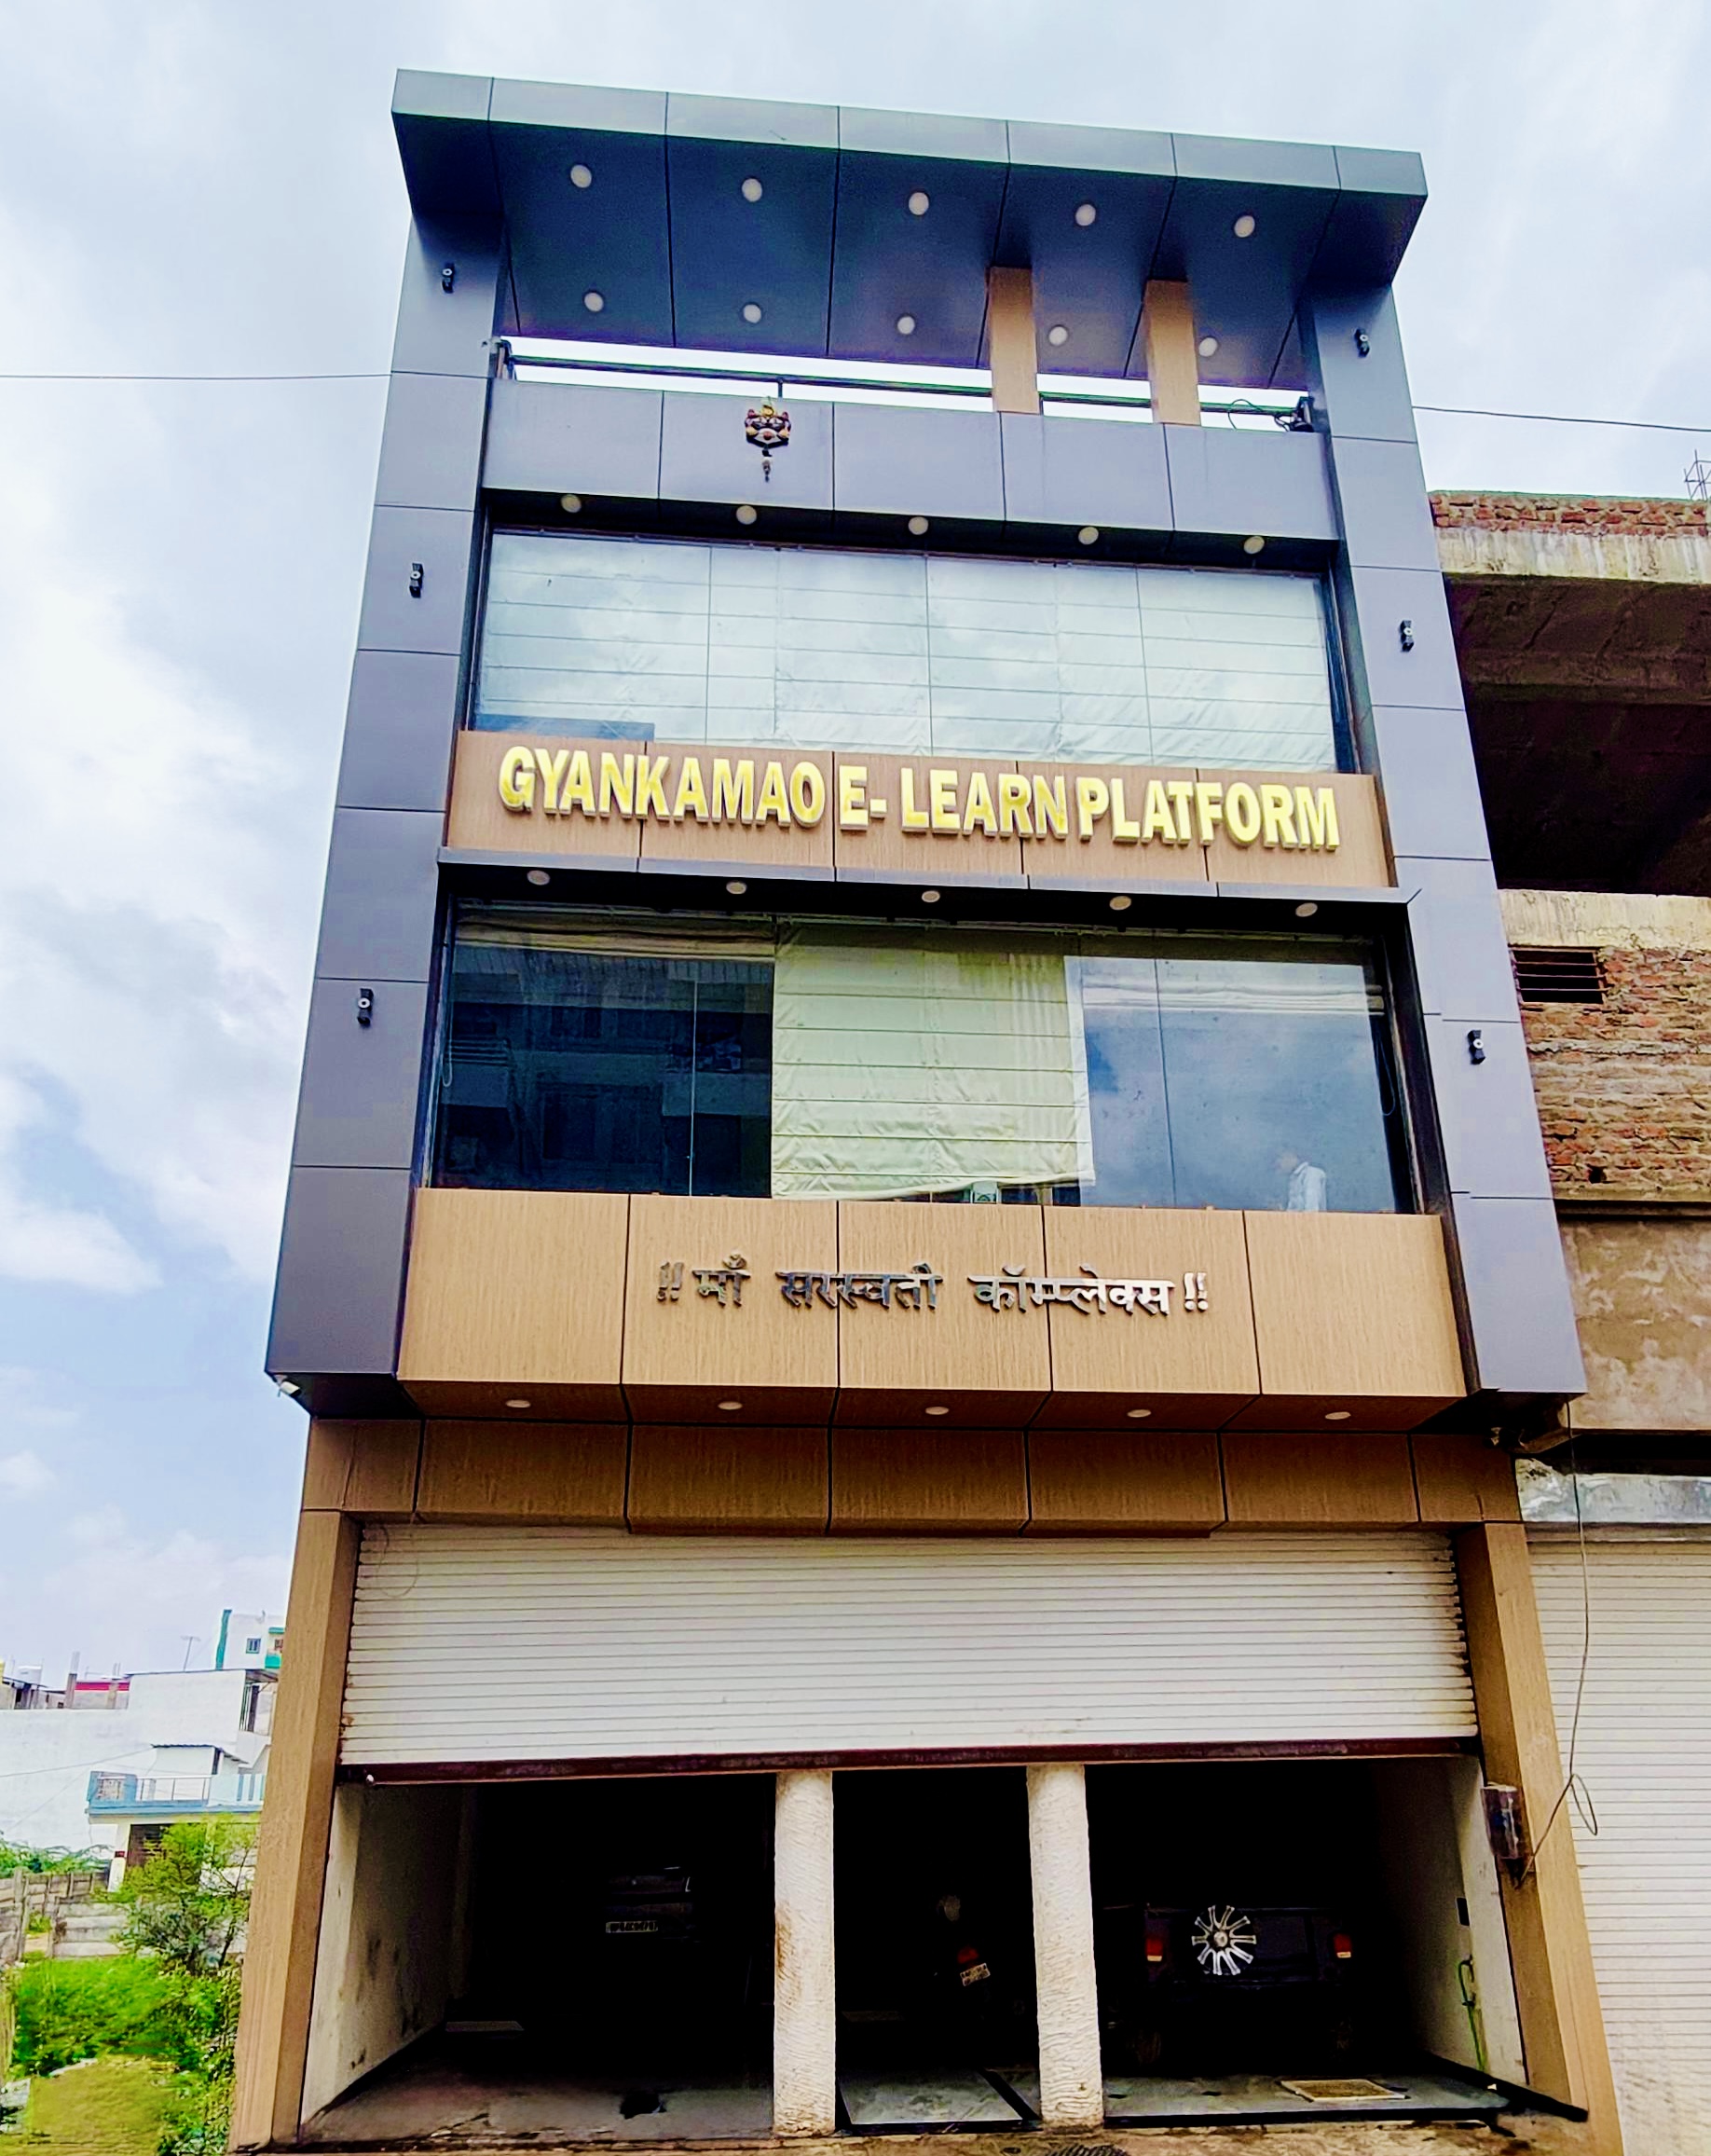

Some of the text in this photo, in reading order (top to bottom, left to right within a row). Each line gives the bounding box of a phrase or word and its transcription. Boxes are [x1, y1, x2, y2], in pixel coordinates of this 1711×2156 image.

[499, 746, 827, 829] GYANKAMAO
[1076, 776, 1340, 852] PLATFORM
[775, 1262, 944, 1310] सरस्वती
